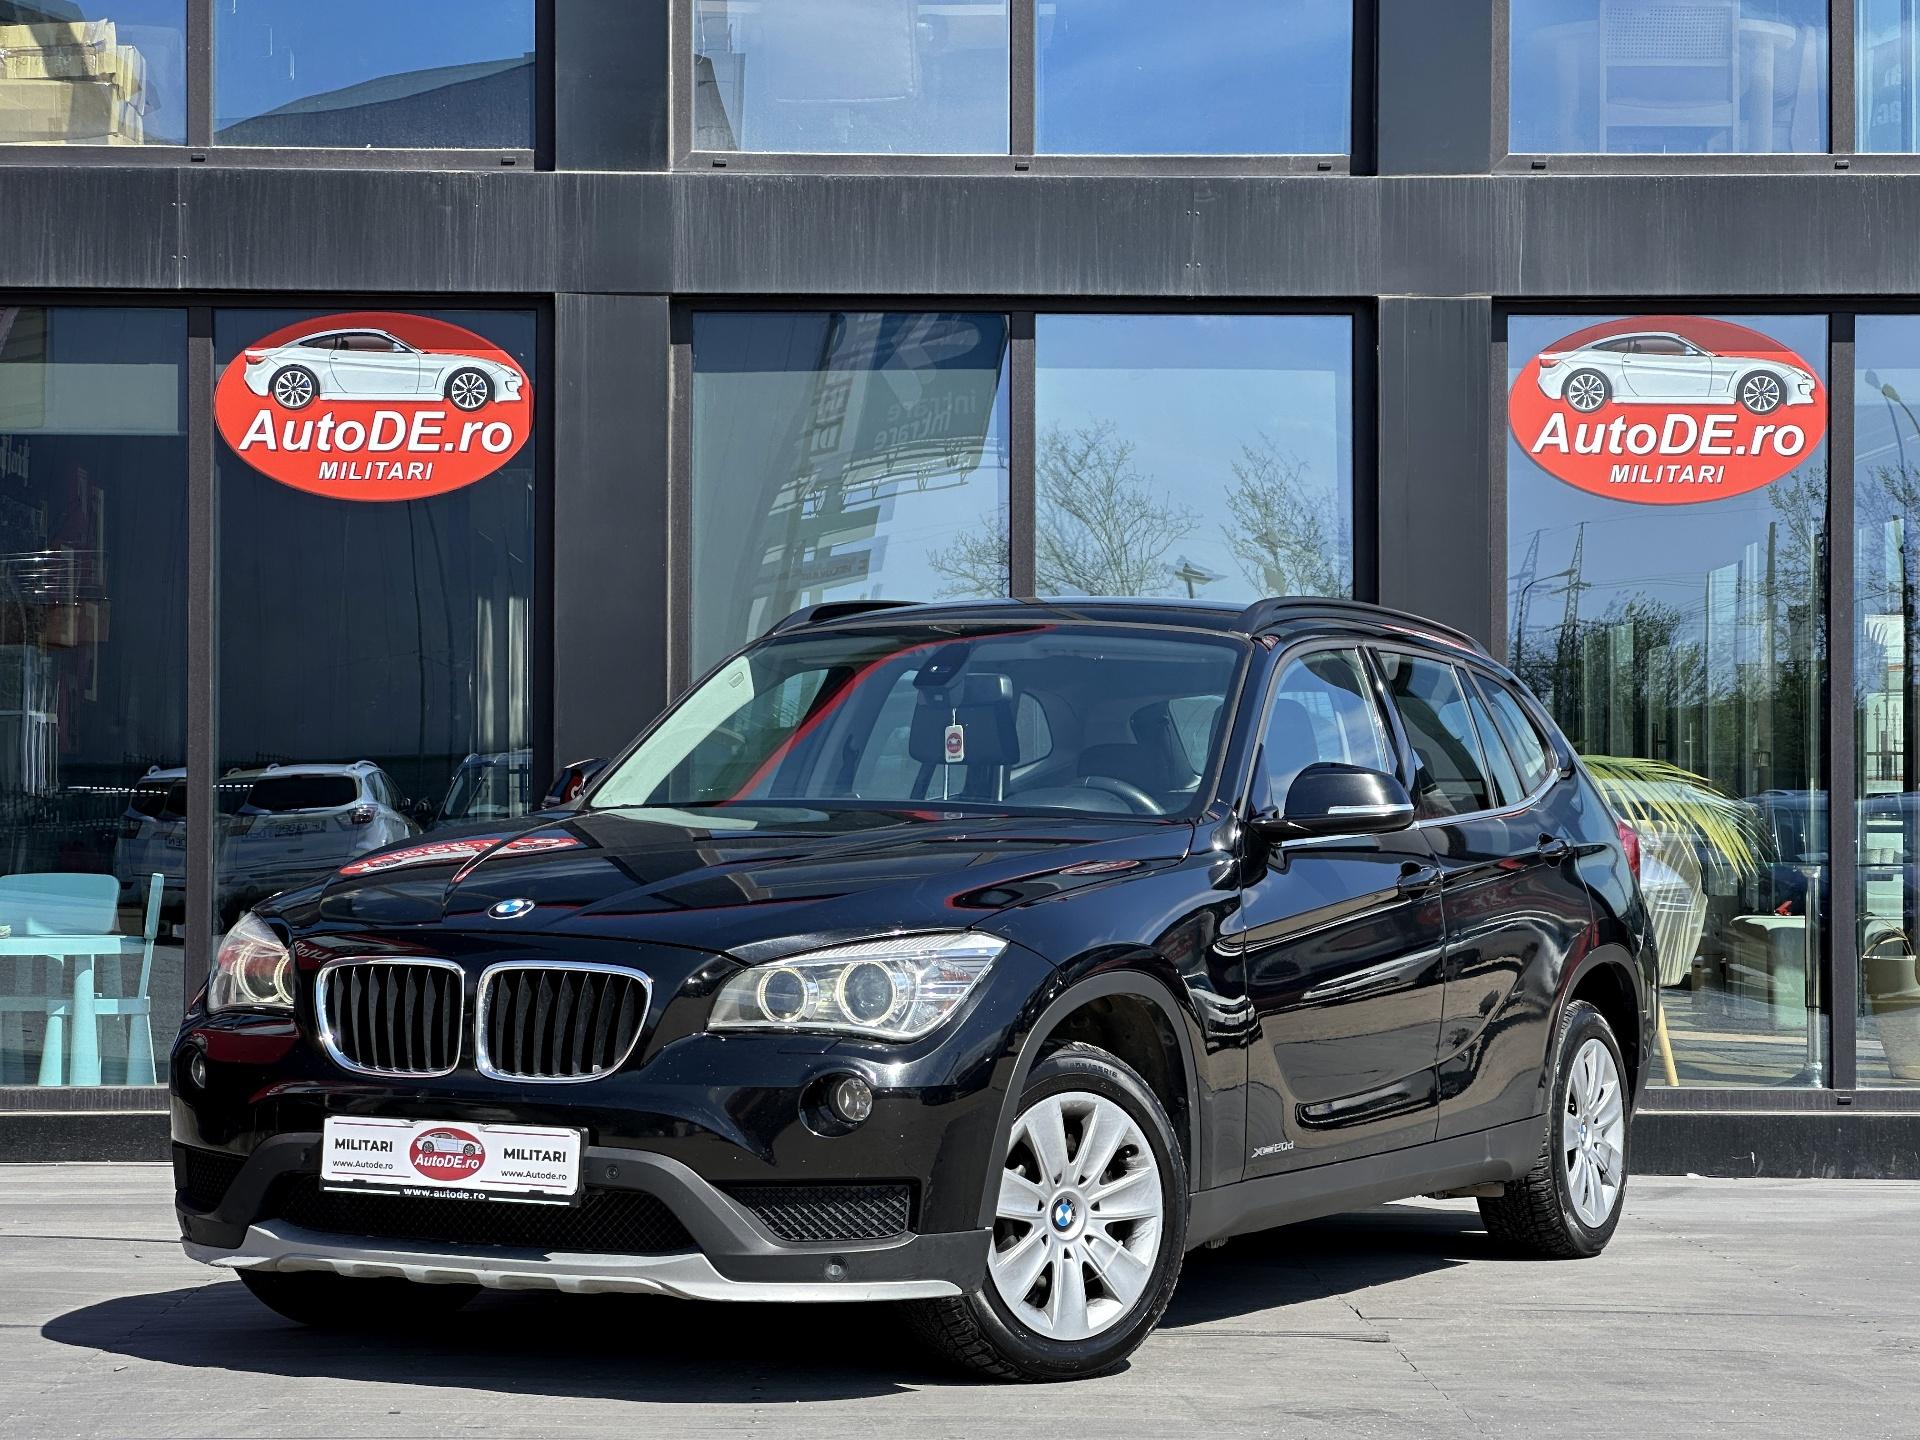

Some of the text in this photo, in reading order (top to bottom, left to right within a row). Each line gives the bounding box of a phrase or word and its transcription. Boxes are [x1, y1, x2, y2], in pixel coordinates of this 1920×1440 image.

[238, 409, 514, 453] AutoDE.ro
[1531, 412, 1806, 457] AutoDE.ro
[318, 461, 434, 481] MILITARI
[1609, 464, 1725, 484] MILITARI
[334, 1137, 394, 1153] MILITARI
[412, 1153, 480, 1170] AutoDE.ro
[503, 1147, 567, 1163] MILITARI
[332, 1159, 394, 1170] www.Autode.ro
[500, 1169, 567, 1181] www.Autode.ro
[403, 1187, 486, 1200] www.autode.ro
